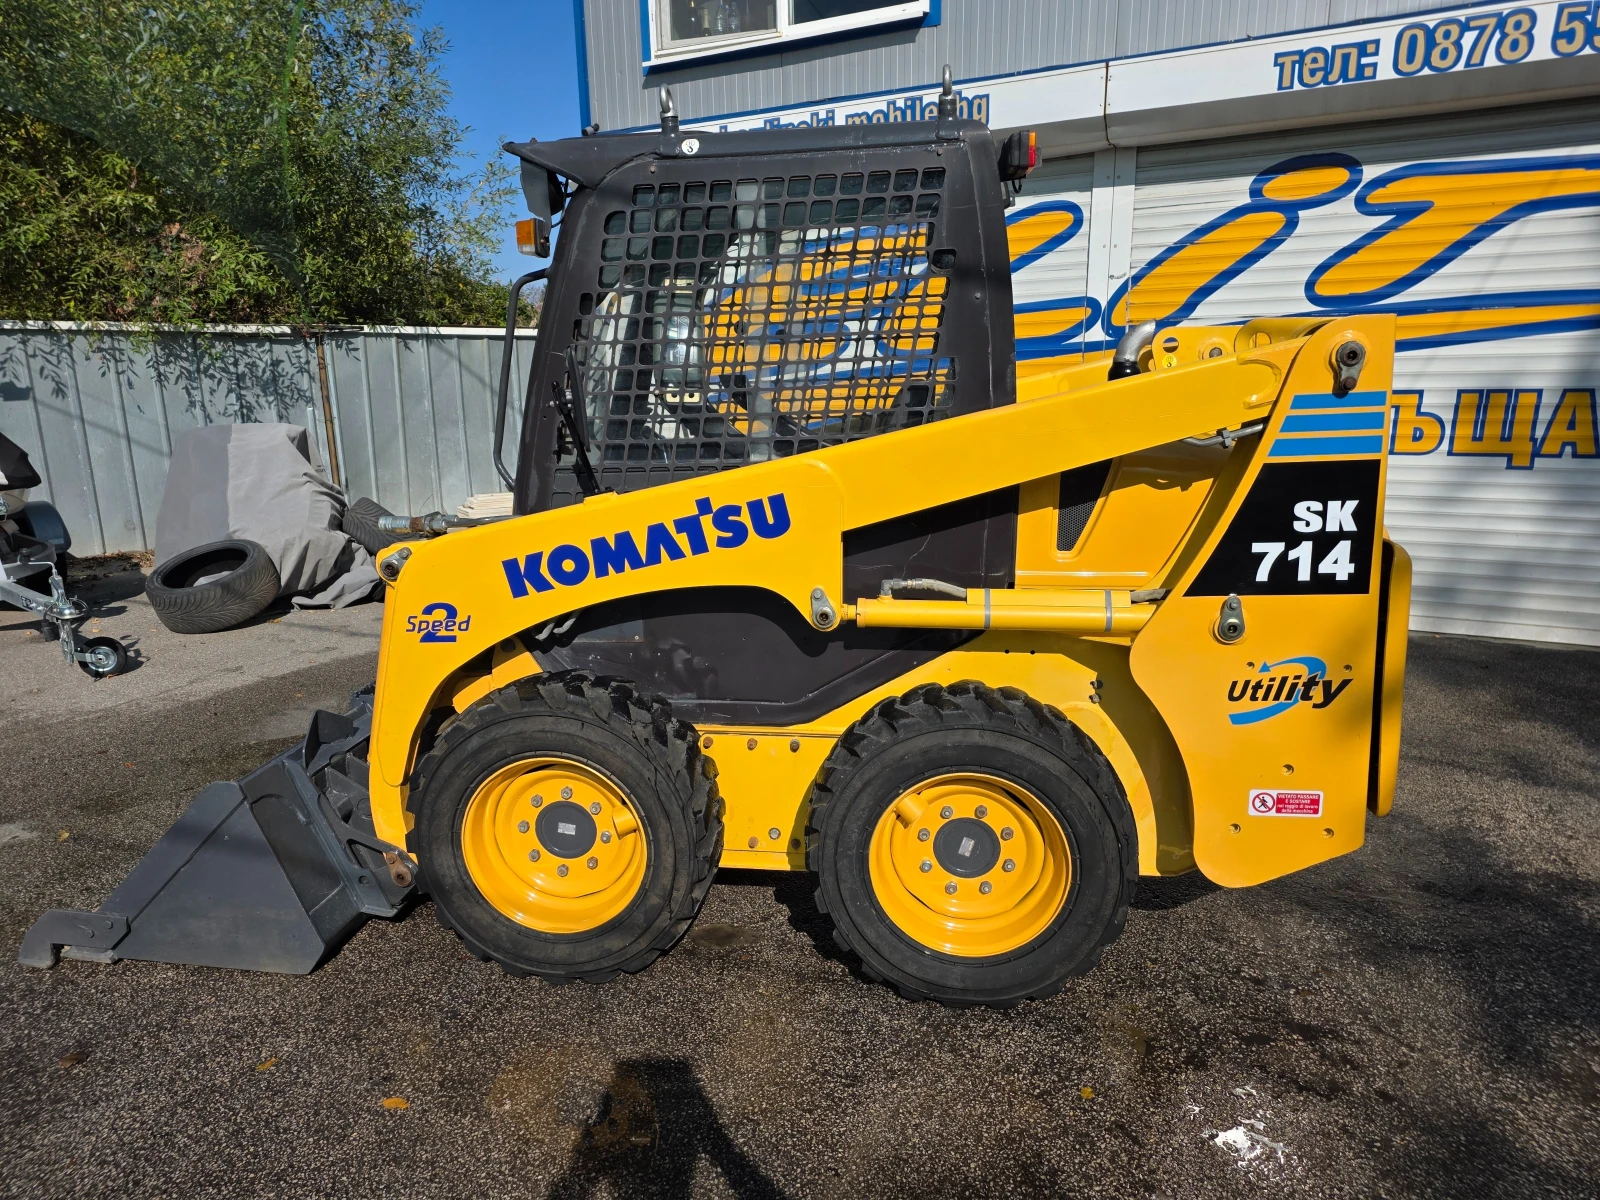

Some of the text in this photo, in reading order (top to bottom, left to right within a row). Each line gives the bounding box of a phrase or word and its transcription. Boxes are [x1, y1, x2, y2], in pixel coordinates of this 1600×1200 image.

[1274, 0, 1600, 91] тел: 0878 5
[1293, 500, 1360, 533] SK
[501, 493, 791, 599] KOMATSU
[1251, 540, 1355, 582] 714
[405, 614, 471, 634] Speed
[419, 602, 460, 643] 2
[1227, 673, 1354, 709] Utility
